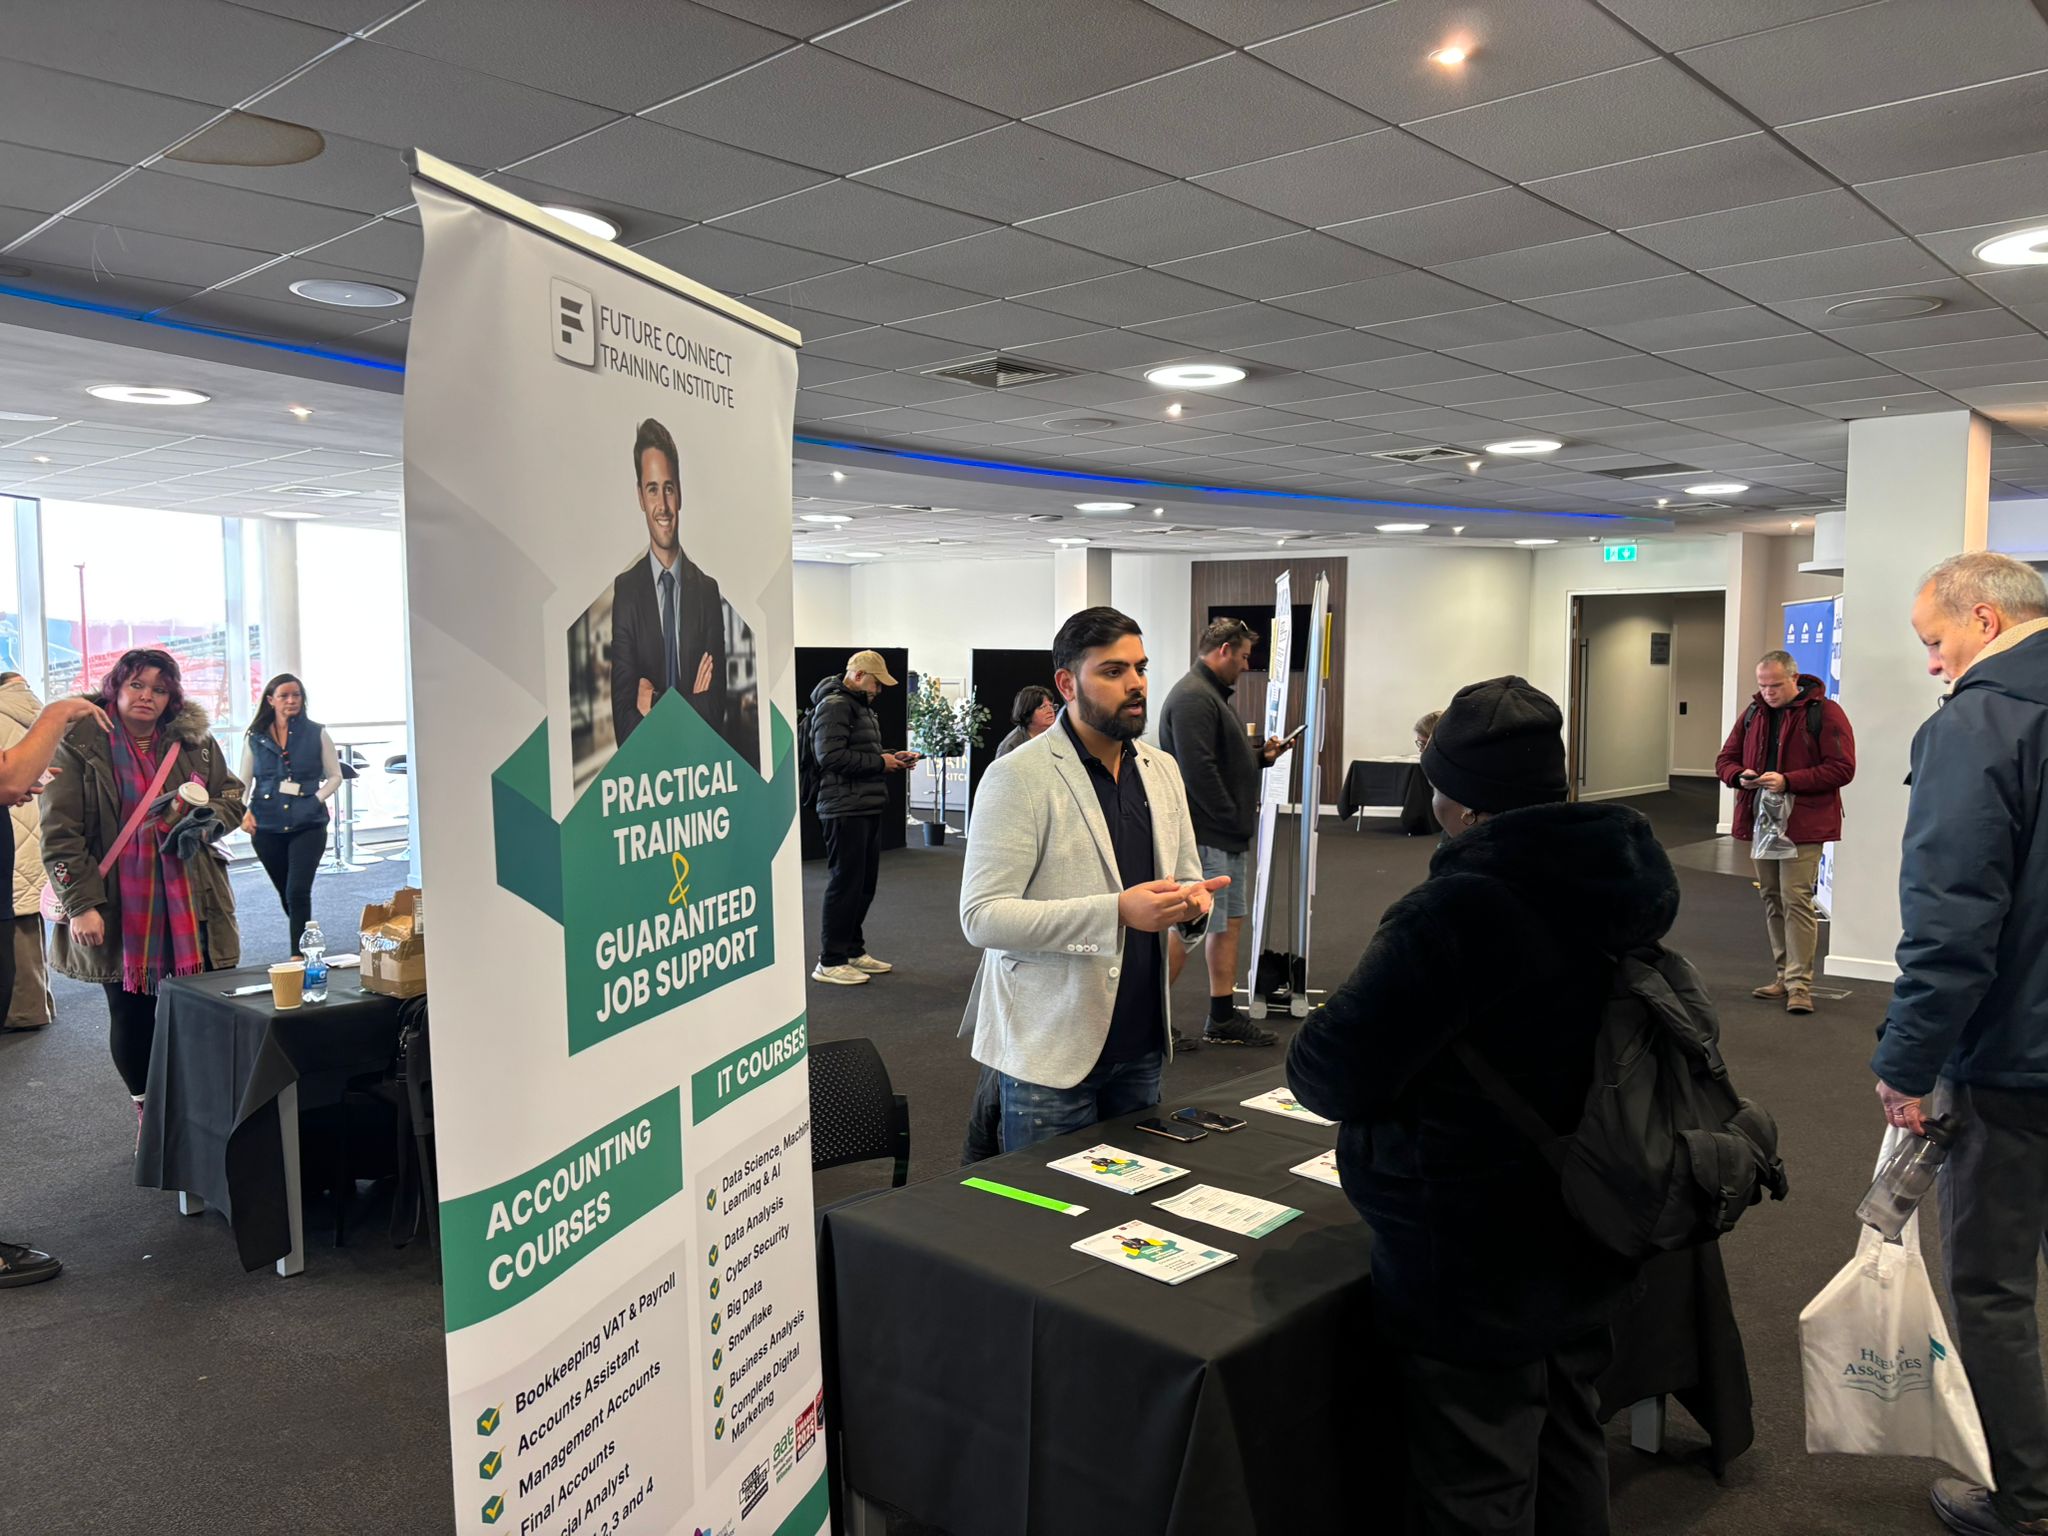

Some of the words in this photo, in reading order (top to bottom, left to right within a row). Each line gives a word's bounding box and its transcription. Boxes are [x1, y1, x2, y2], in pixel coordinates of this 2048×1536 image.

[600, 305, 662, 351] FUTURE
[666, 332, 732, 377] CONNECT
[600, 343, 669, 387] TRAINING
[673, 368, 734, 408] INSTITUTE
[601, 760, 738, 817] PRACTICAL
[613, 806, 730, 865] TRAINING
[668, 851, 690, 909] &
[596, 885, 756, 970] GUARANTEED
[597, 968, 651, 1023] JOB
[655, 925, 758, 997] SUPPORT
[717, 1065, 733, 1098] IT
[737, 1023, 805, 1085] COURSES
[486, 1118, 651, 1241] ACCOUNTING
[722, 1171, 743, 1193] Data
[744, 1143, 783, 1177] Science,
[723, 1179, 761, 1217] Learning
[763, 1172, 770, 1187] &
[771, 1163, 781, 1179] AI
[488, 1191, 611, 1291] COURSES
[724, 1228, 745, 1251] Data
[746, 1197, 784, 1231] Analysis
[725, 1252, 752, 1283] Cyber
[753, 1224, 790, 1260] Security
[727, 1297, 742, 1320] Big
[743, 1280, 763, 1305] Data
[728, 1302, 773, 1352] Snowflake
[515, 1334, 601, 1414] Bookkeeping
[603, 1310, 626, 1341] VAT
[629, 1303, 637, 1321] &
[639, 1272, 676, 1313] Payroll
[729, 1345, 768, 1389] Business
[769, 1309, 805, 1350] Analysis
[518, 1391, 582, 1456] Accounts
[585, 1339, 640, 1398] Assistant
[730, 1371, 772, 1420] Complete
[772, 1342, 800, 1375] Digital
[519, 1408, 604, 1498] Management
[606, 1361, 661, 1419] Accounts
[731, 1390, 775, 1443] Marketing
[773, 1426, 795, 1462] aat
[520, 1495, 555, 1536] Final
[557, 1440, 615, 1506] Accounts
[584, 1463, 630, 1521] Analyst
[622, 1486, 644, 1515] and
[646, 1476, 654, 1494] 4
